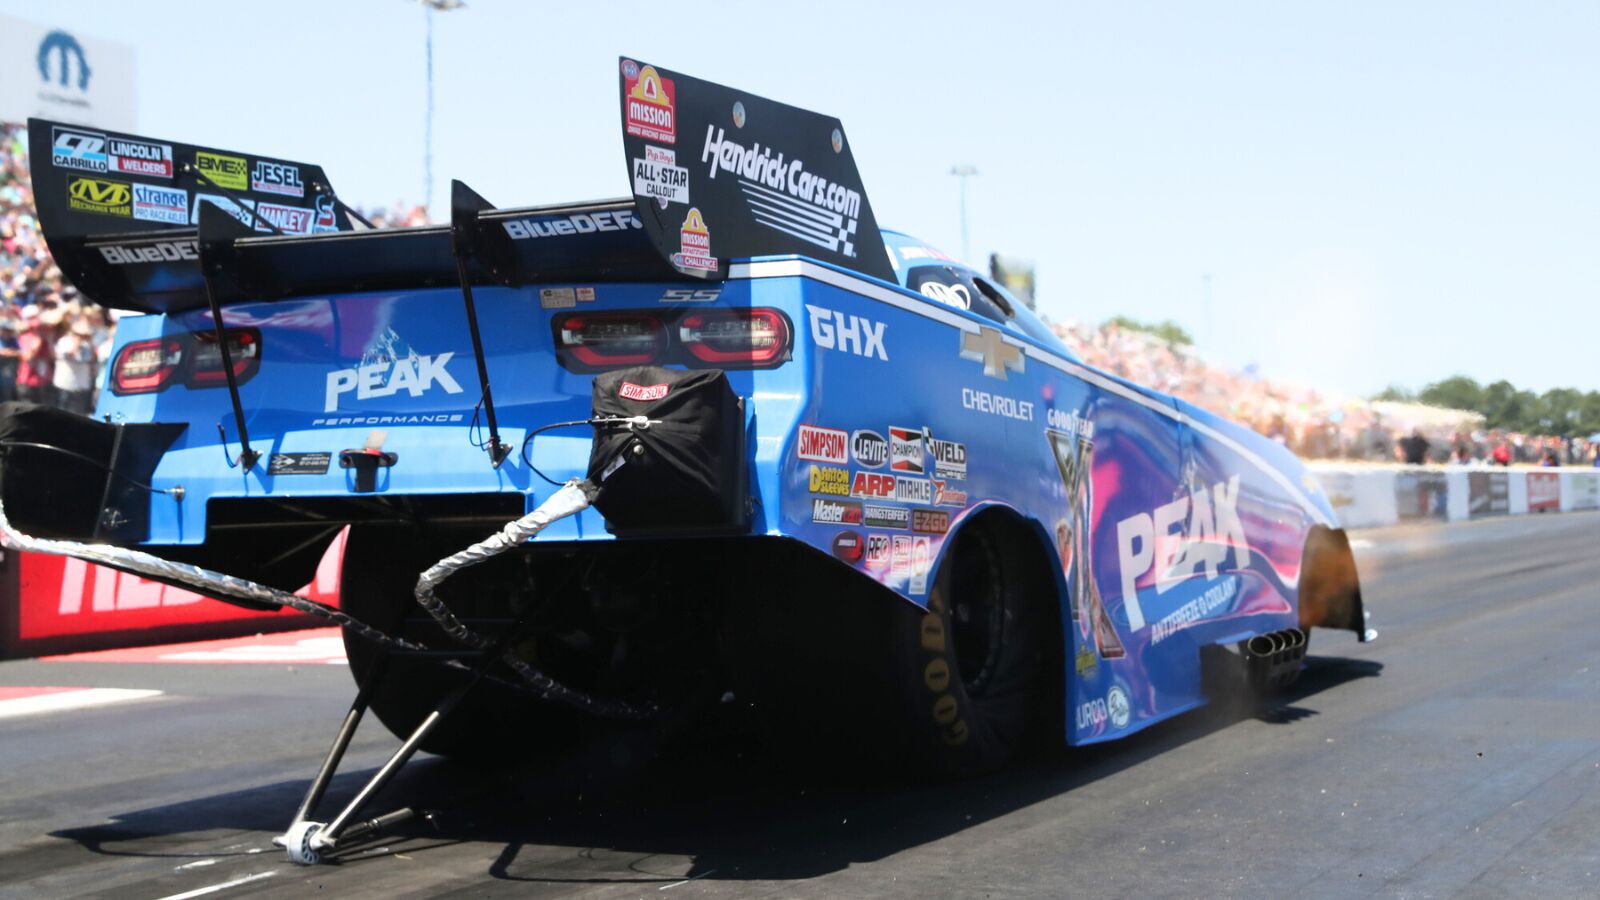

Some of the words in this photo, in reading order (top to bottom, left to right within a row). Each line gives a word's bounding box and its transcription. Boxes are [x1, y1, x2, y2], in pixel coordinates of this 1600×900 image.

[630, 102, 671, 128] MISSION
[110, 141, 161, 160] LINCOLN
[54, 155, 106, 171] CARRILLO
[122, 159, 166, 174] WELDERS
[702, 124, 861, 219] HendrickCars.com
[253, 161, 304, 188] JESEL
[135, 187, 186, 208] strange
[646, 183, 676, 198] CALLOUT
[109, 204, 131, 215] WEAR
[259, 206, 306, 233] MANLEY
[502, 210, 635, 240] BlueDEF
[682, 233, 709, 248] MISSION
[685, 256, 717, 268] CHALLENGE
[658, 289, 723, 303] SS
[805, 304, 889, 361] GHX
[324, 352, 464, 413] PEAK
[623, 384, 668, 400] SIMPSON
[962, 388, 1034, 422] CHEVROLET
[312, 414, 463, 426] PERFORMANCE
[800, 428, 846, 460] SIMPSON
[852, 433, 889, 462] CLEVITE
[893, 442, 923, 458] CHAMPION
[934, 441, 966, 464] WELD
[852, 472, 896, 497] ARP
[898, 479, 930, 501] MAHLE
[1117, 474, 1250, 632] PEAK
